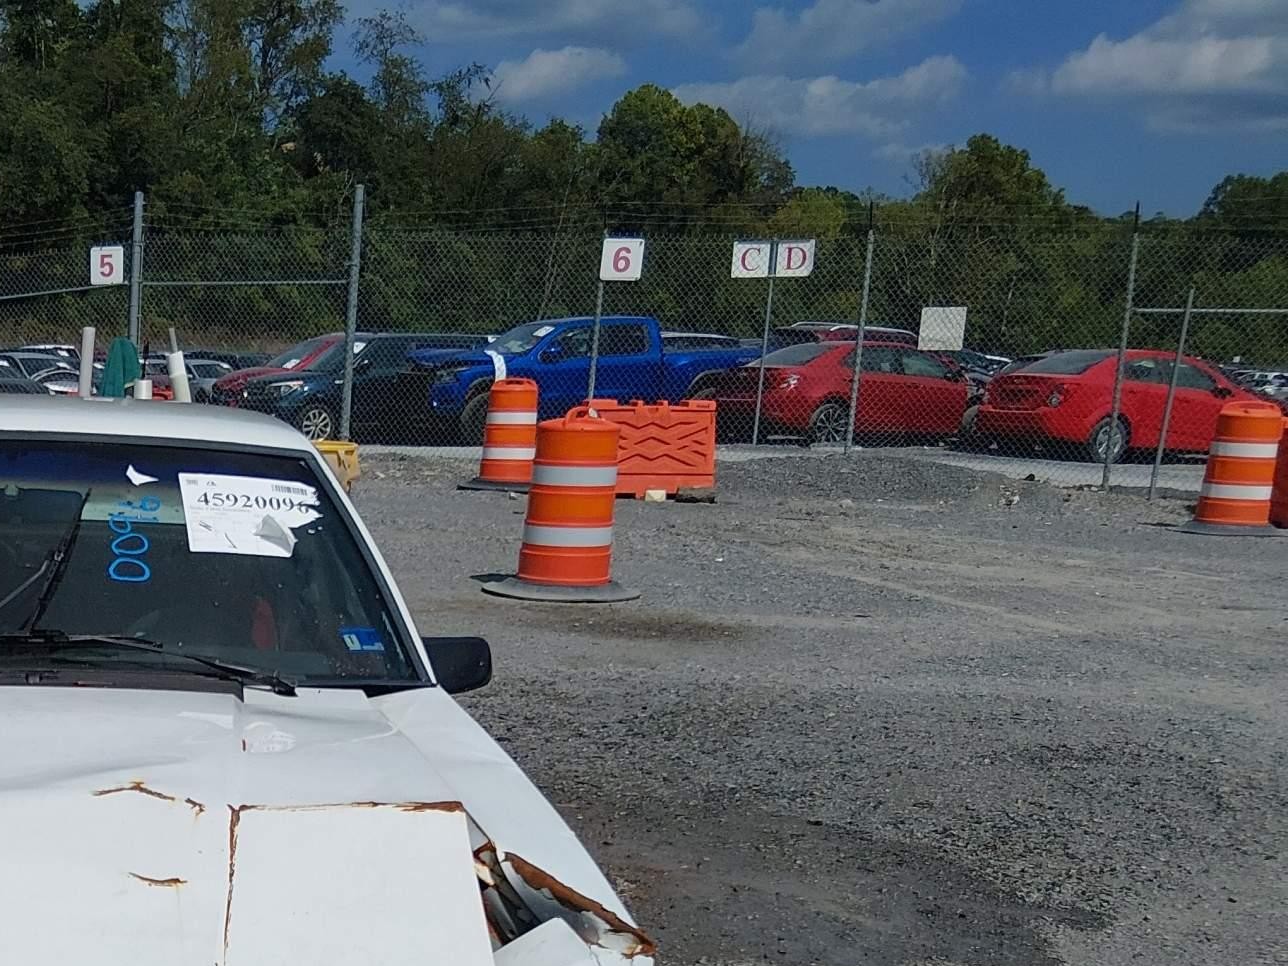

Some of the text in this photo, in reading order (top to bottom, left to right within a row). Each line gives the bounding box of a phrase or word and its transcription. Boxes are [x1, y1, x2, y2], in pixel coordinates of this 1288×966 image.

[99, 253, 114, 278] 5
[612, 246, 631, 273] 6
[740, 247, 761, 272] C
[783, 246, 808, 271] D
